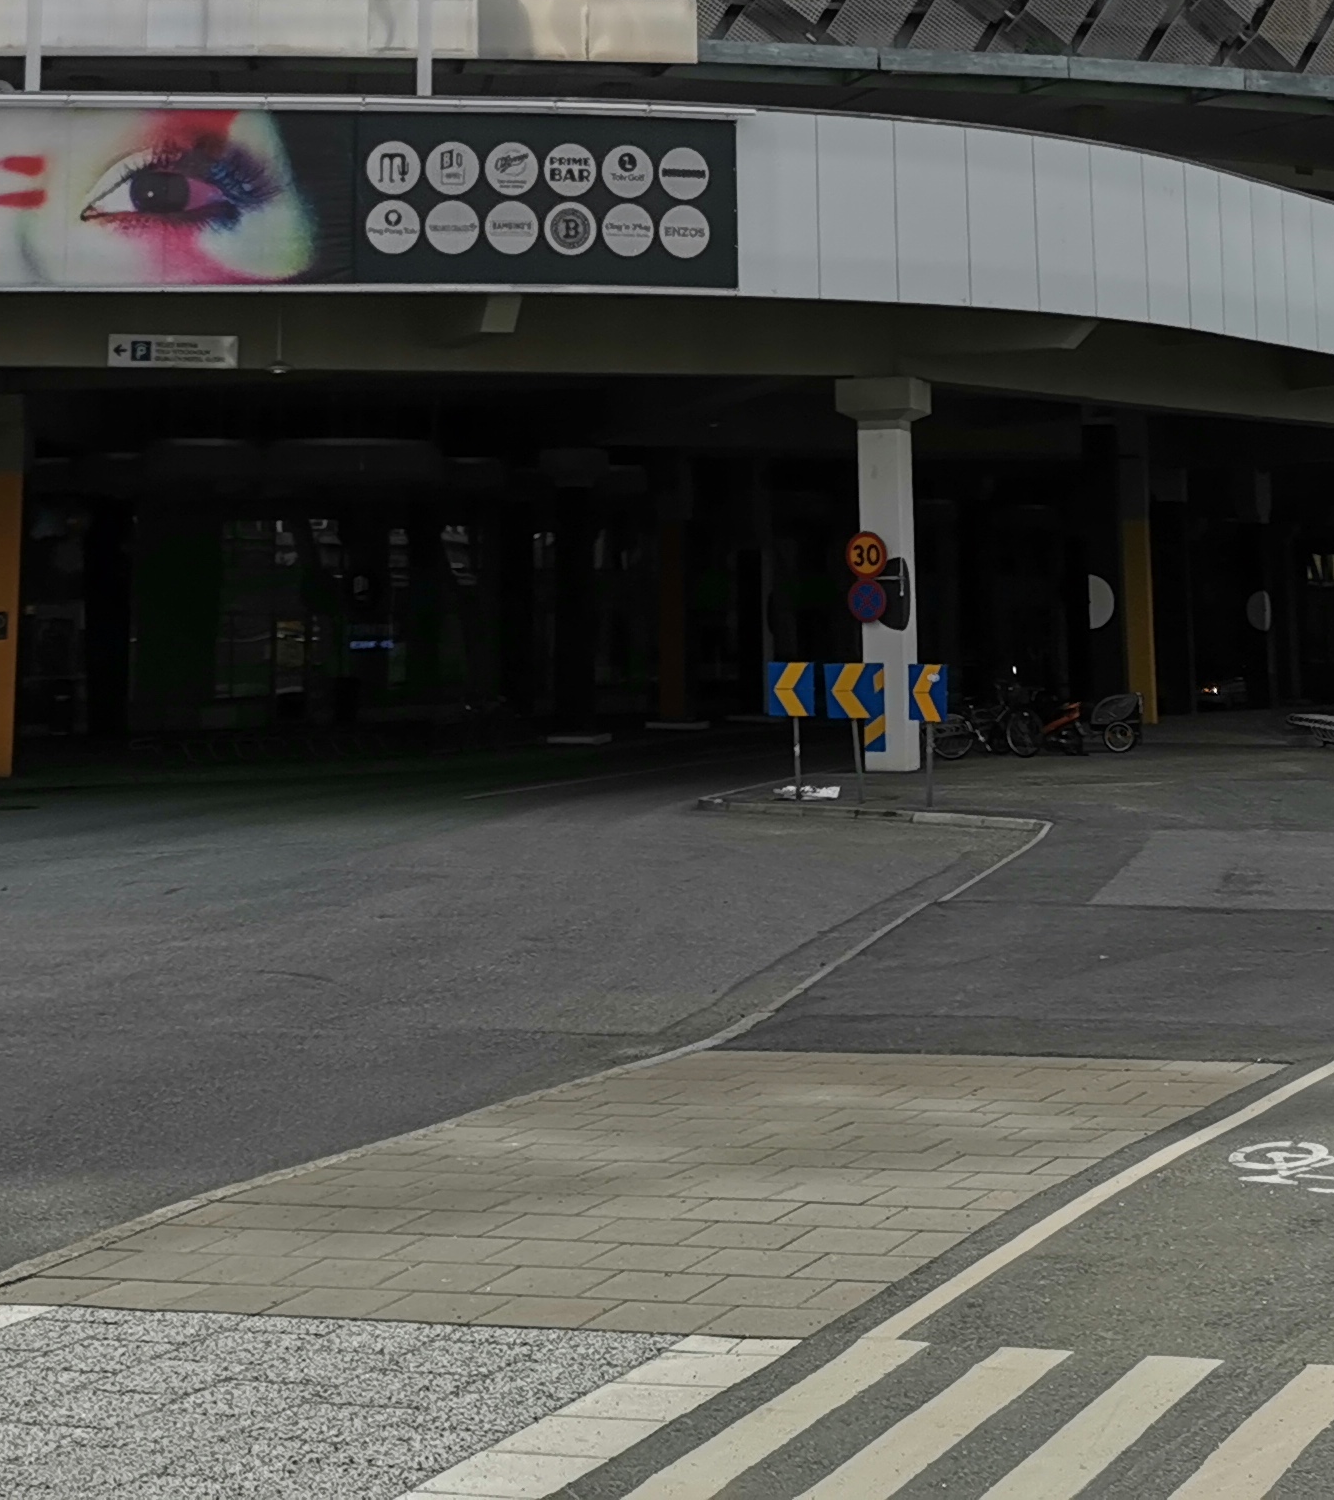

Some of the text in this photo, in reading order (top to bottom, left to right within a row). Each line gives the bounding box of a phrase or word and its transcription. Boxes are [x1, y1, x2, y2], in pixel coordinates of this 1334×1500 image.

[549, 156, 590, 167] PRIME
[549, 168, 591, 182] BAR
[664, 226, 705, 238] ENZOS
[853, 544, 880, 567] 30
